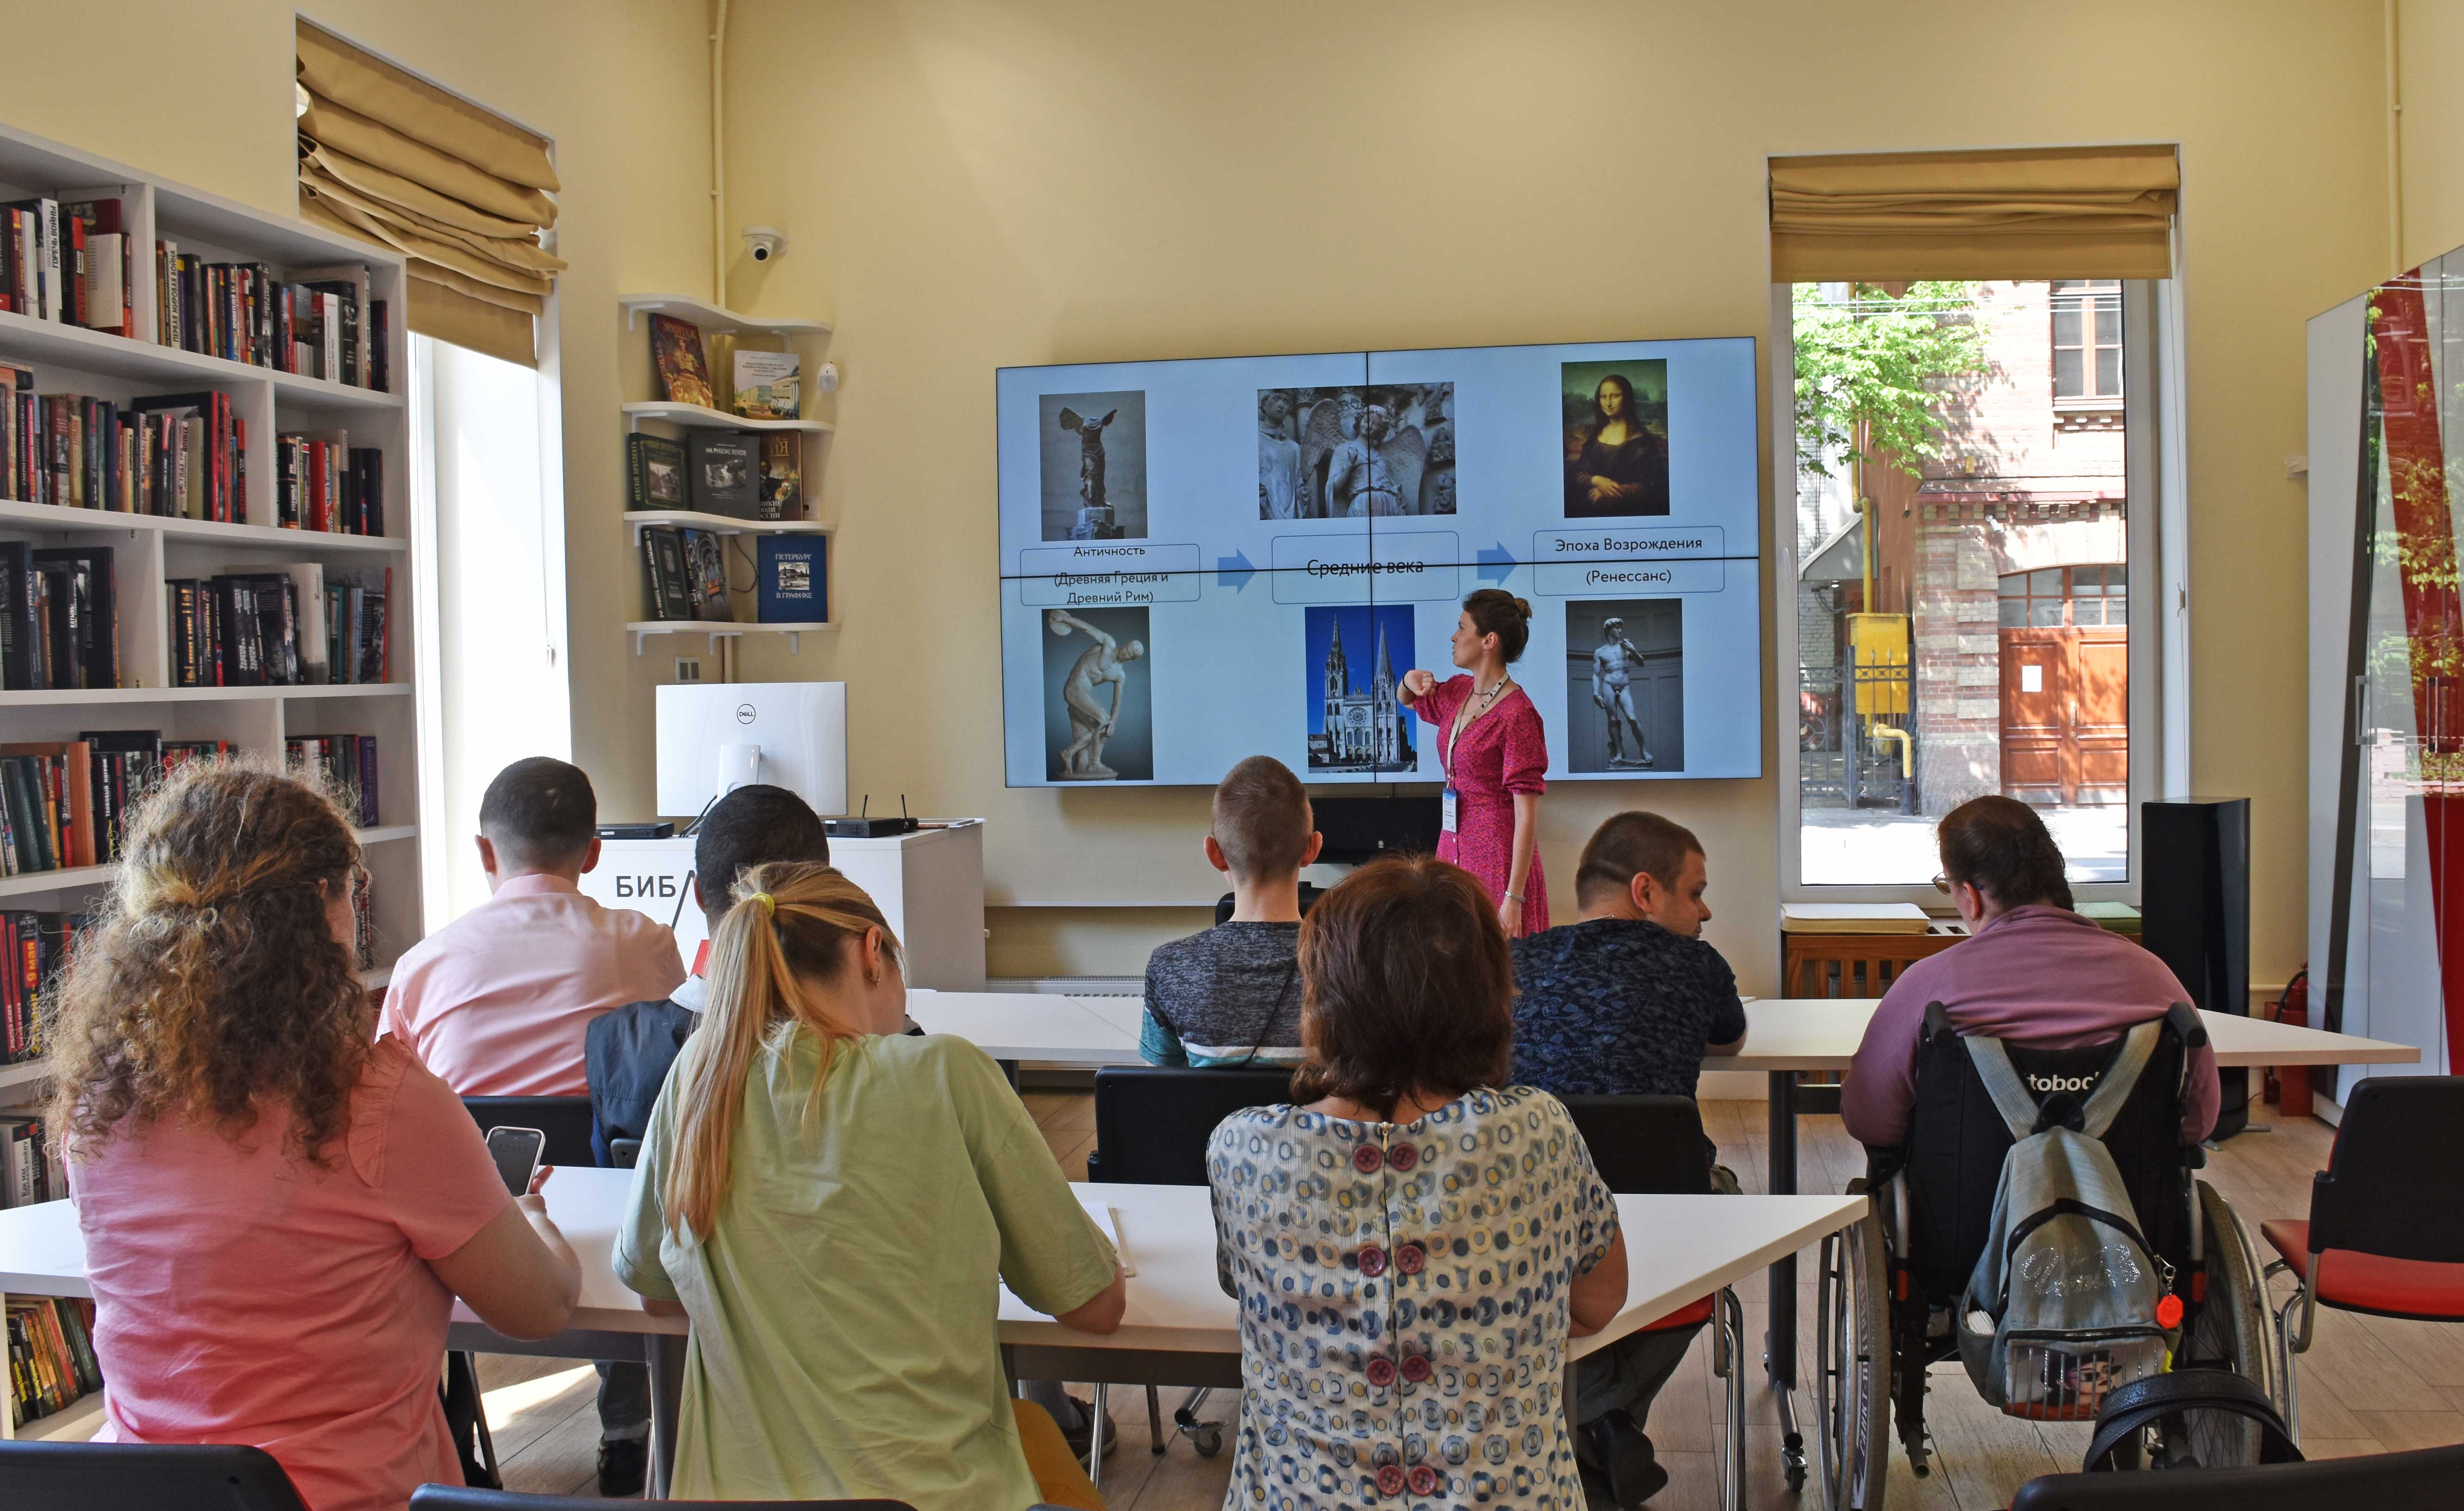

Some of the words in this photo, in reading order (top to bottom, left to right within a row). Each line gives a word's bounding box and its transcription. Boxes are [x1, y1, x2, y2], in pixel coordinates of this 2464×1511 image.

[1073, 546, 1146, 557] Античность
[1555, 539, 1599, 552] Эпоха
[1604, 538, 1702, 553] Возрождения
[1307, 559, 1382, 578] Средние
[1386, 561, 1424, 573] века
[1053, 573, 1110, 587] (Древняя
[1114, 571, 1157, 585] Греция
[1161, 573, 1169, 582] и
[1586, 569, 1672, 585] (Ренессанс)
[1066, 592, 1121, 604] Древний
[1126, 590, 1154, 603] Рим)
[26, 942, 36, 970] мая
[26, 972, 36, 981] 9
[2027, 1071, 2100, 1092] toboc
[21, 1168, 26, 1180] мы
